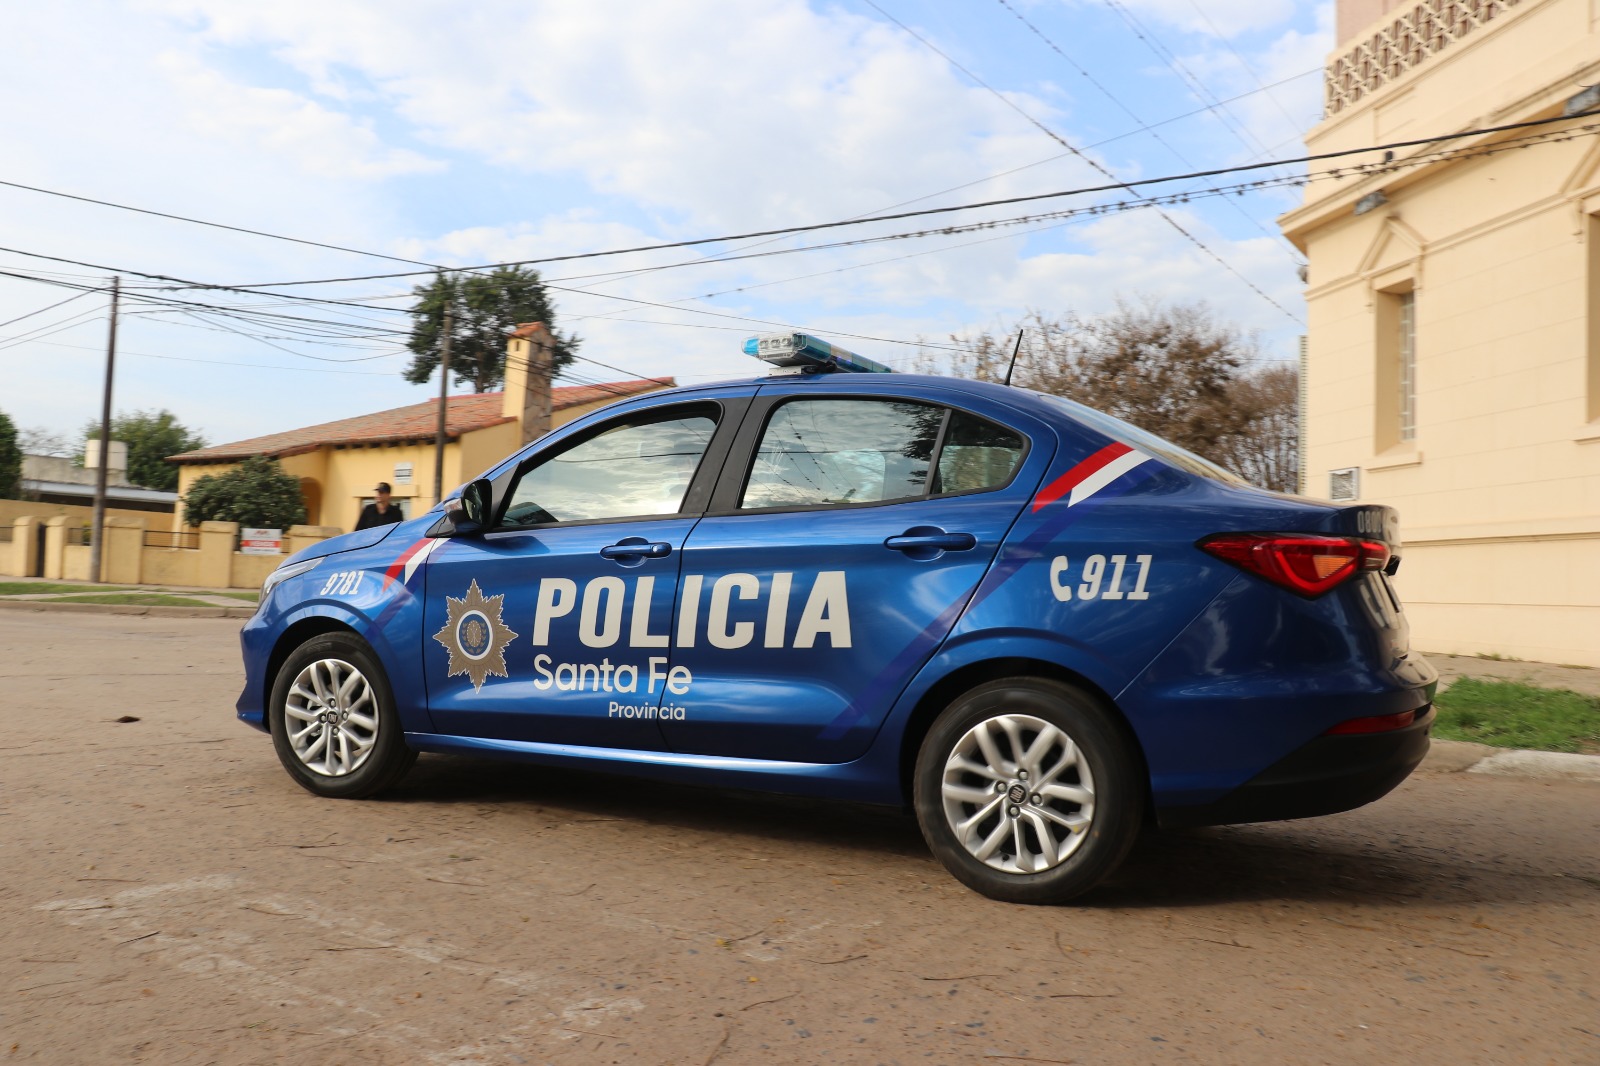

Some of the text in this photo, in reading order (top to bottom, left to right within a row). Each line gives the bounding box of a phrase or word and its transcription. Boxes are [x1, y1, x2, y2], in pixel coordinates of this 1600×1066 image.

[320, 570, 364, 595] 9781
[1077, 554, 1152, 600] 911
[532, 570, 852, 649] POLICIA
[533, 654, 692, 695] Santa Fe
[608, 701, 686, 720] Provincia
